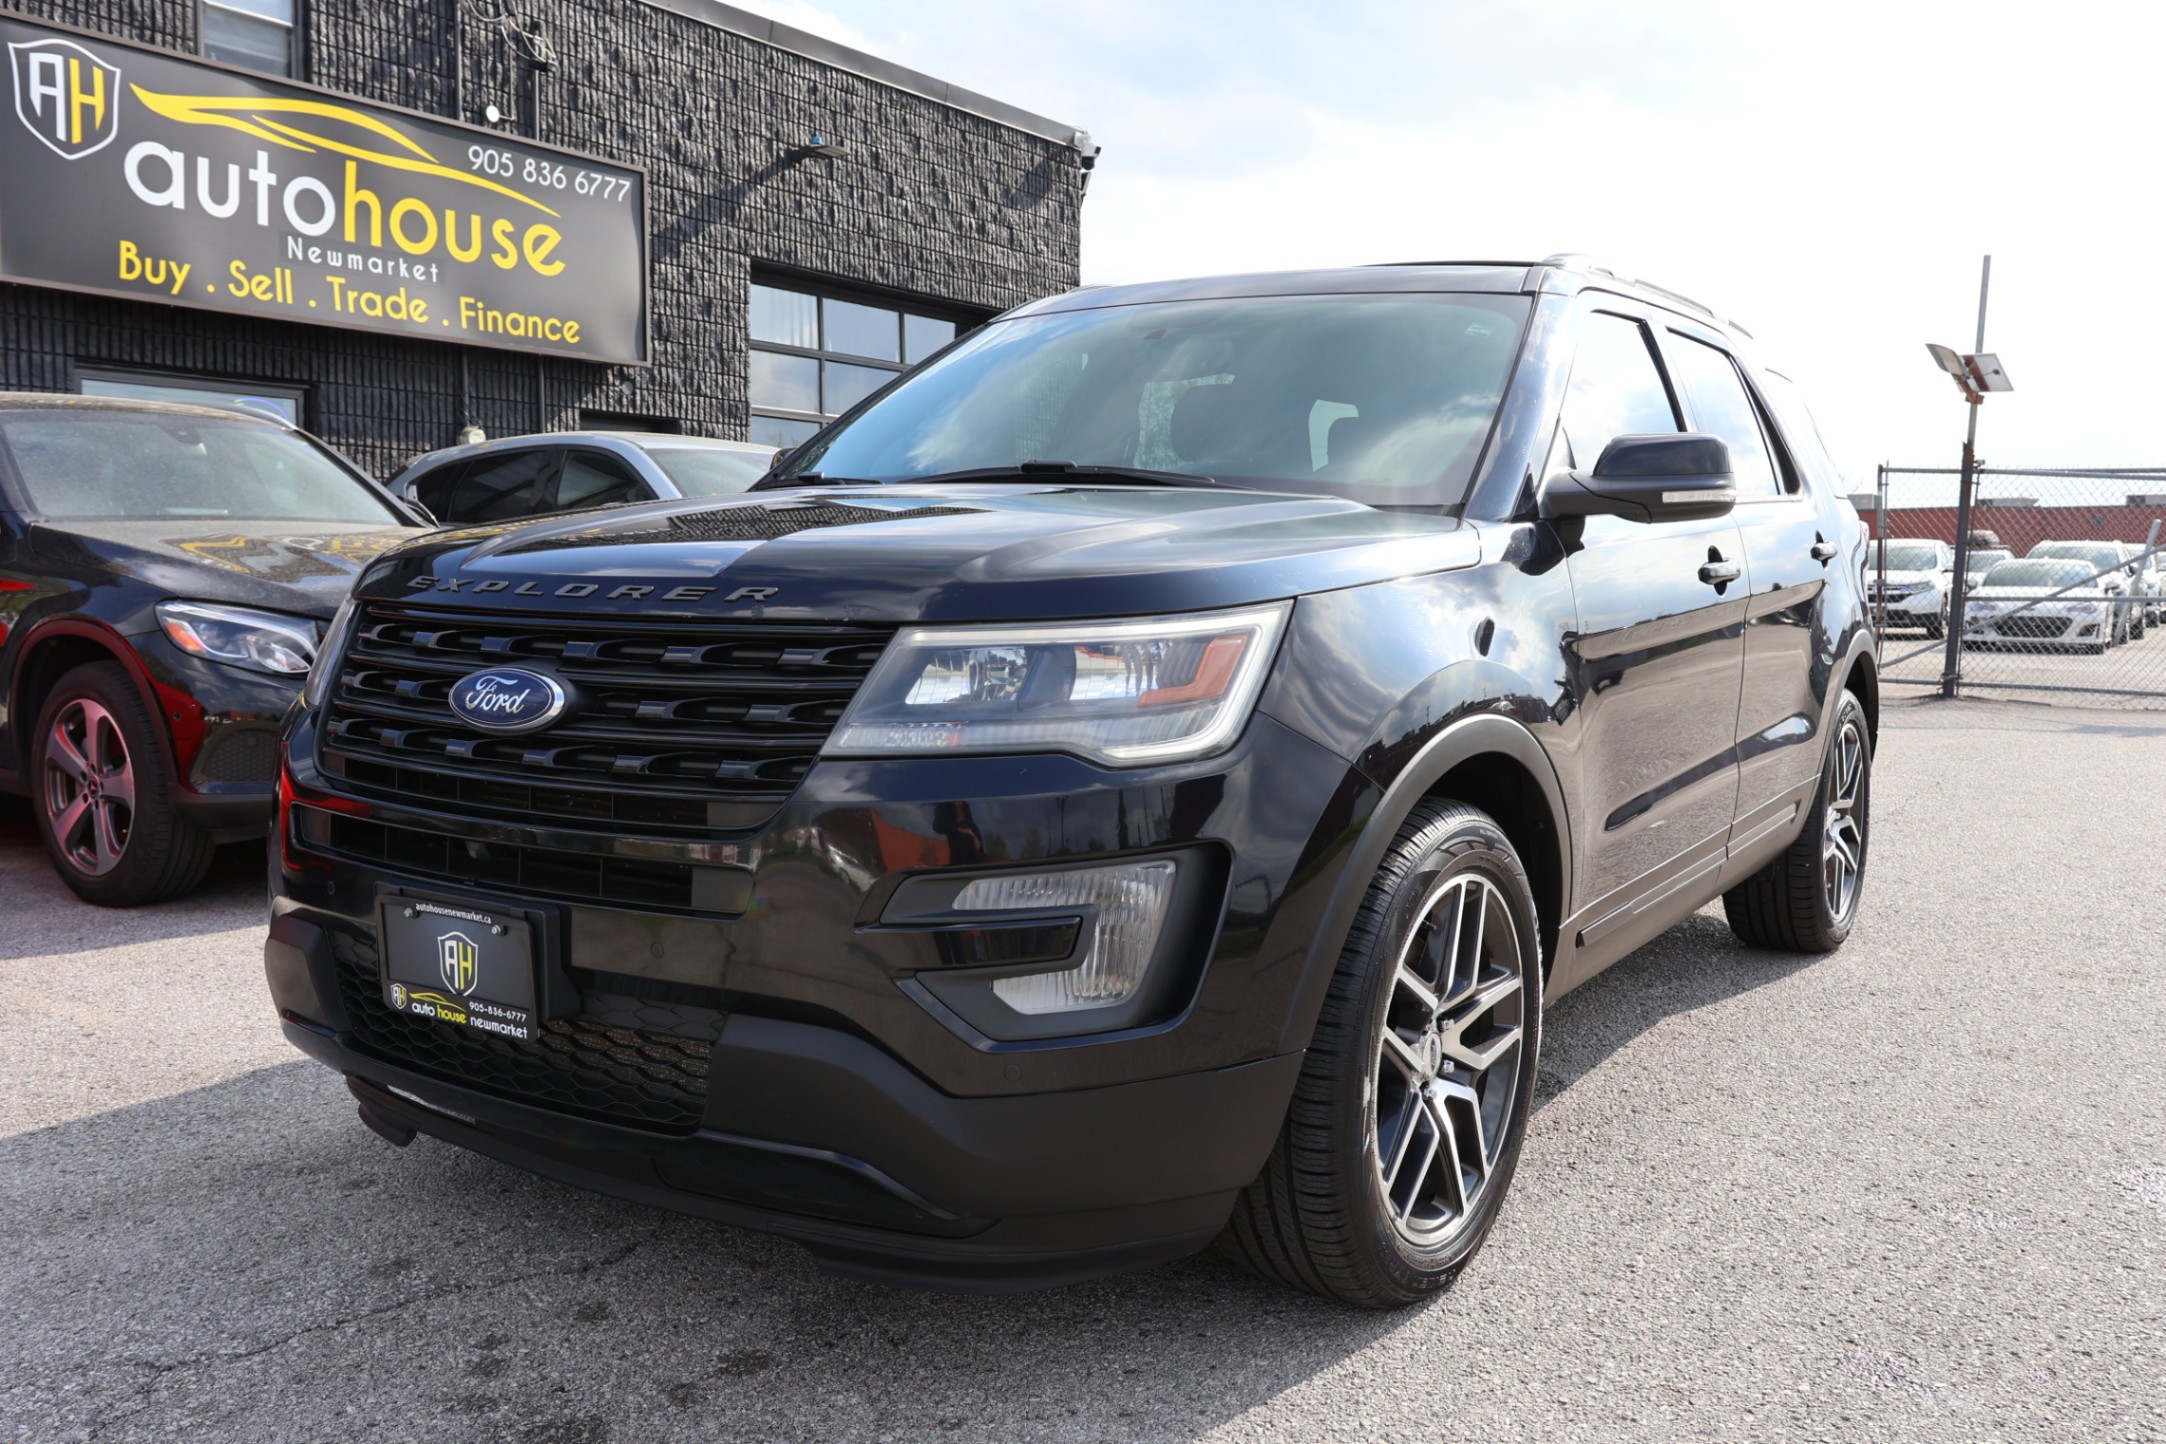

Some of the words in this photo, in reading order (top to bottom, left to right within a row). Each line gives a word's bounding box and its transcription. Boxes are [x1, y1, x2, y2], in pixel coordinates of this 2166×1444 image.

[29, 52, 105, 145] AH
[468, 145, 515, 178] 905
[522, 158, 568, 190] 836
[574, 171, 632, 203] 6777
[123, 140, 566, 276] autohouse
[286, 235, 440, 284] Newmarket
[118, 240, 191, 296] Buy
[227, 260, 294, 305] Sell
[325, 275, 430, 323] Trade
[459, 297, 581, 344] Finance
[406, 575, 779, 602] EXPLORER
[465, 675, 532, 714] Ford
[415, 902, 492, 925] autohousenewmarket.ca
[444, 939, 473, 991] AH
[411, 1002, 436, 1017] auto
[437, 1005, 467, 1024] house
[470, 1016, 528, 1040] newmarket
[469, 1001, 527, 1023] 905-836-6777
